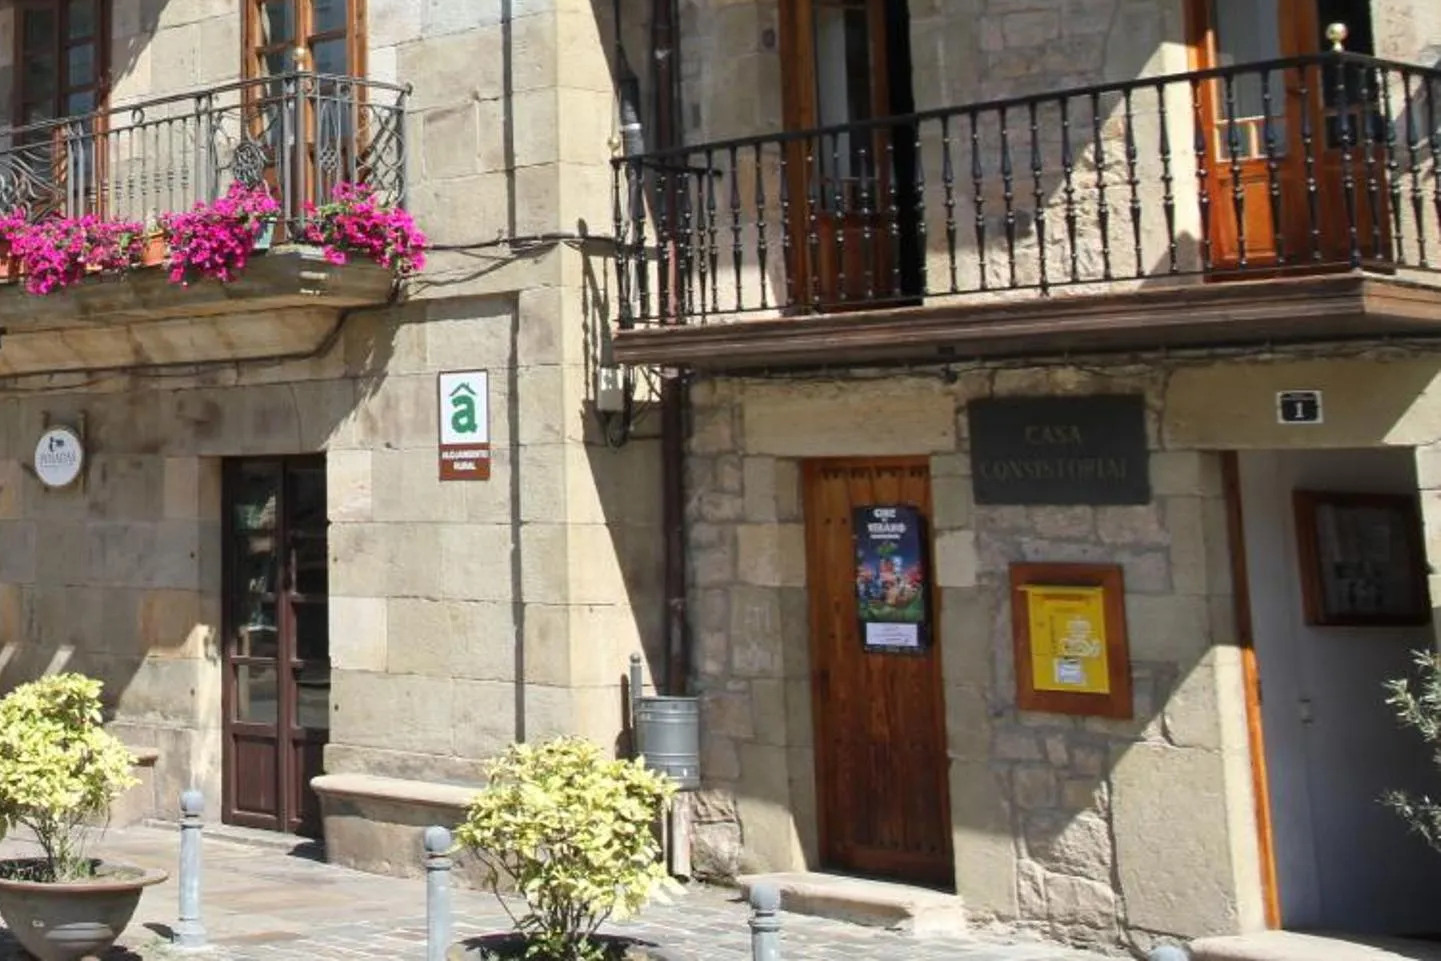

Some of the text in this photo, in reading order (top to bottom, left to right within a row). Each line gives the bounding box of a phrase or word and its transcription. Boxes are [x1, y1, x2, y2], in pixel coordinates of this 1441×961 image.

[1294, 401, 1304, 418] 1
[1025, 425, 1083, 445] CASA
[980, 457, 1129, 480] CONSISTORIAL
